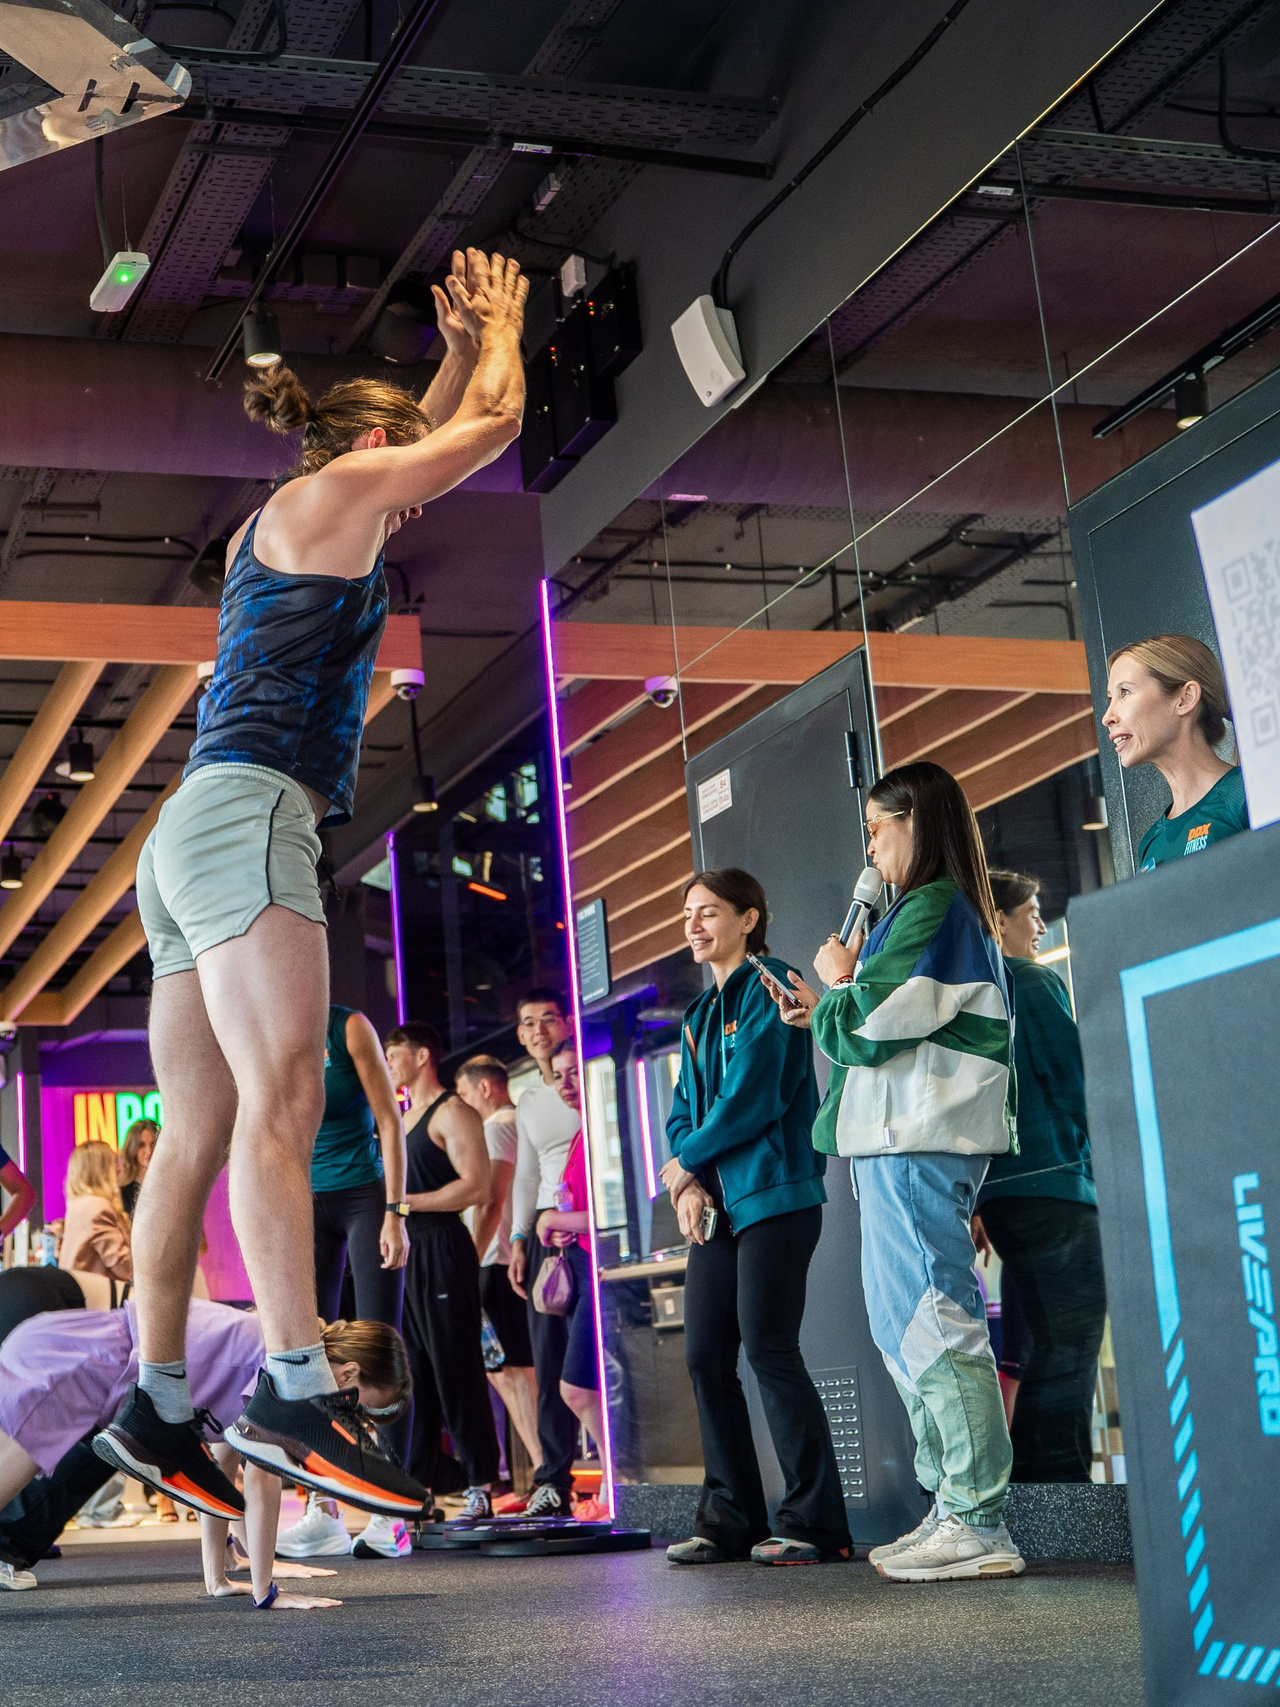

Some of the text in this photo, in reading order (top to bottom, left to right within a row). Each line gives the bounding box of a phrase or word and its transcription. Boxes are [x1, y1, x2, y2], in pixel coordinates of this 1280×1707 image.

[1187, 823, 1212, 841] DDX
[1184, 835, 1208, 855] FITNESS
[1233, 1172, 1280, 1437] LIVEPRO
